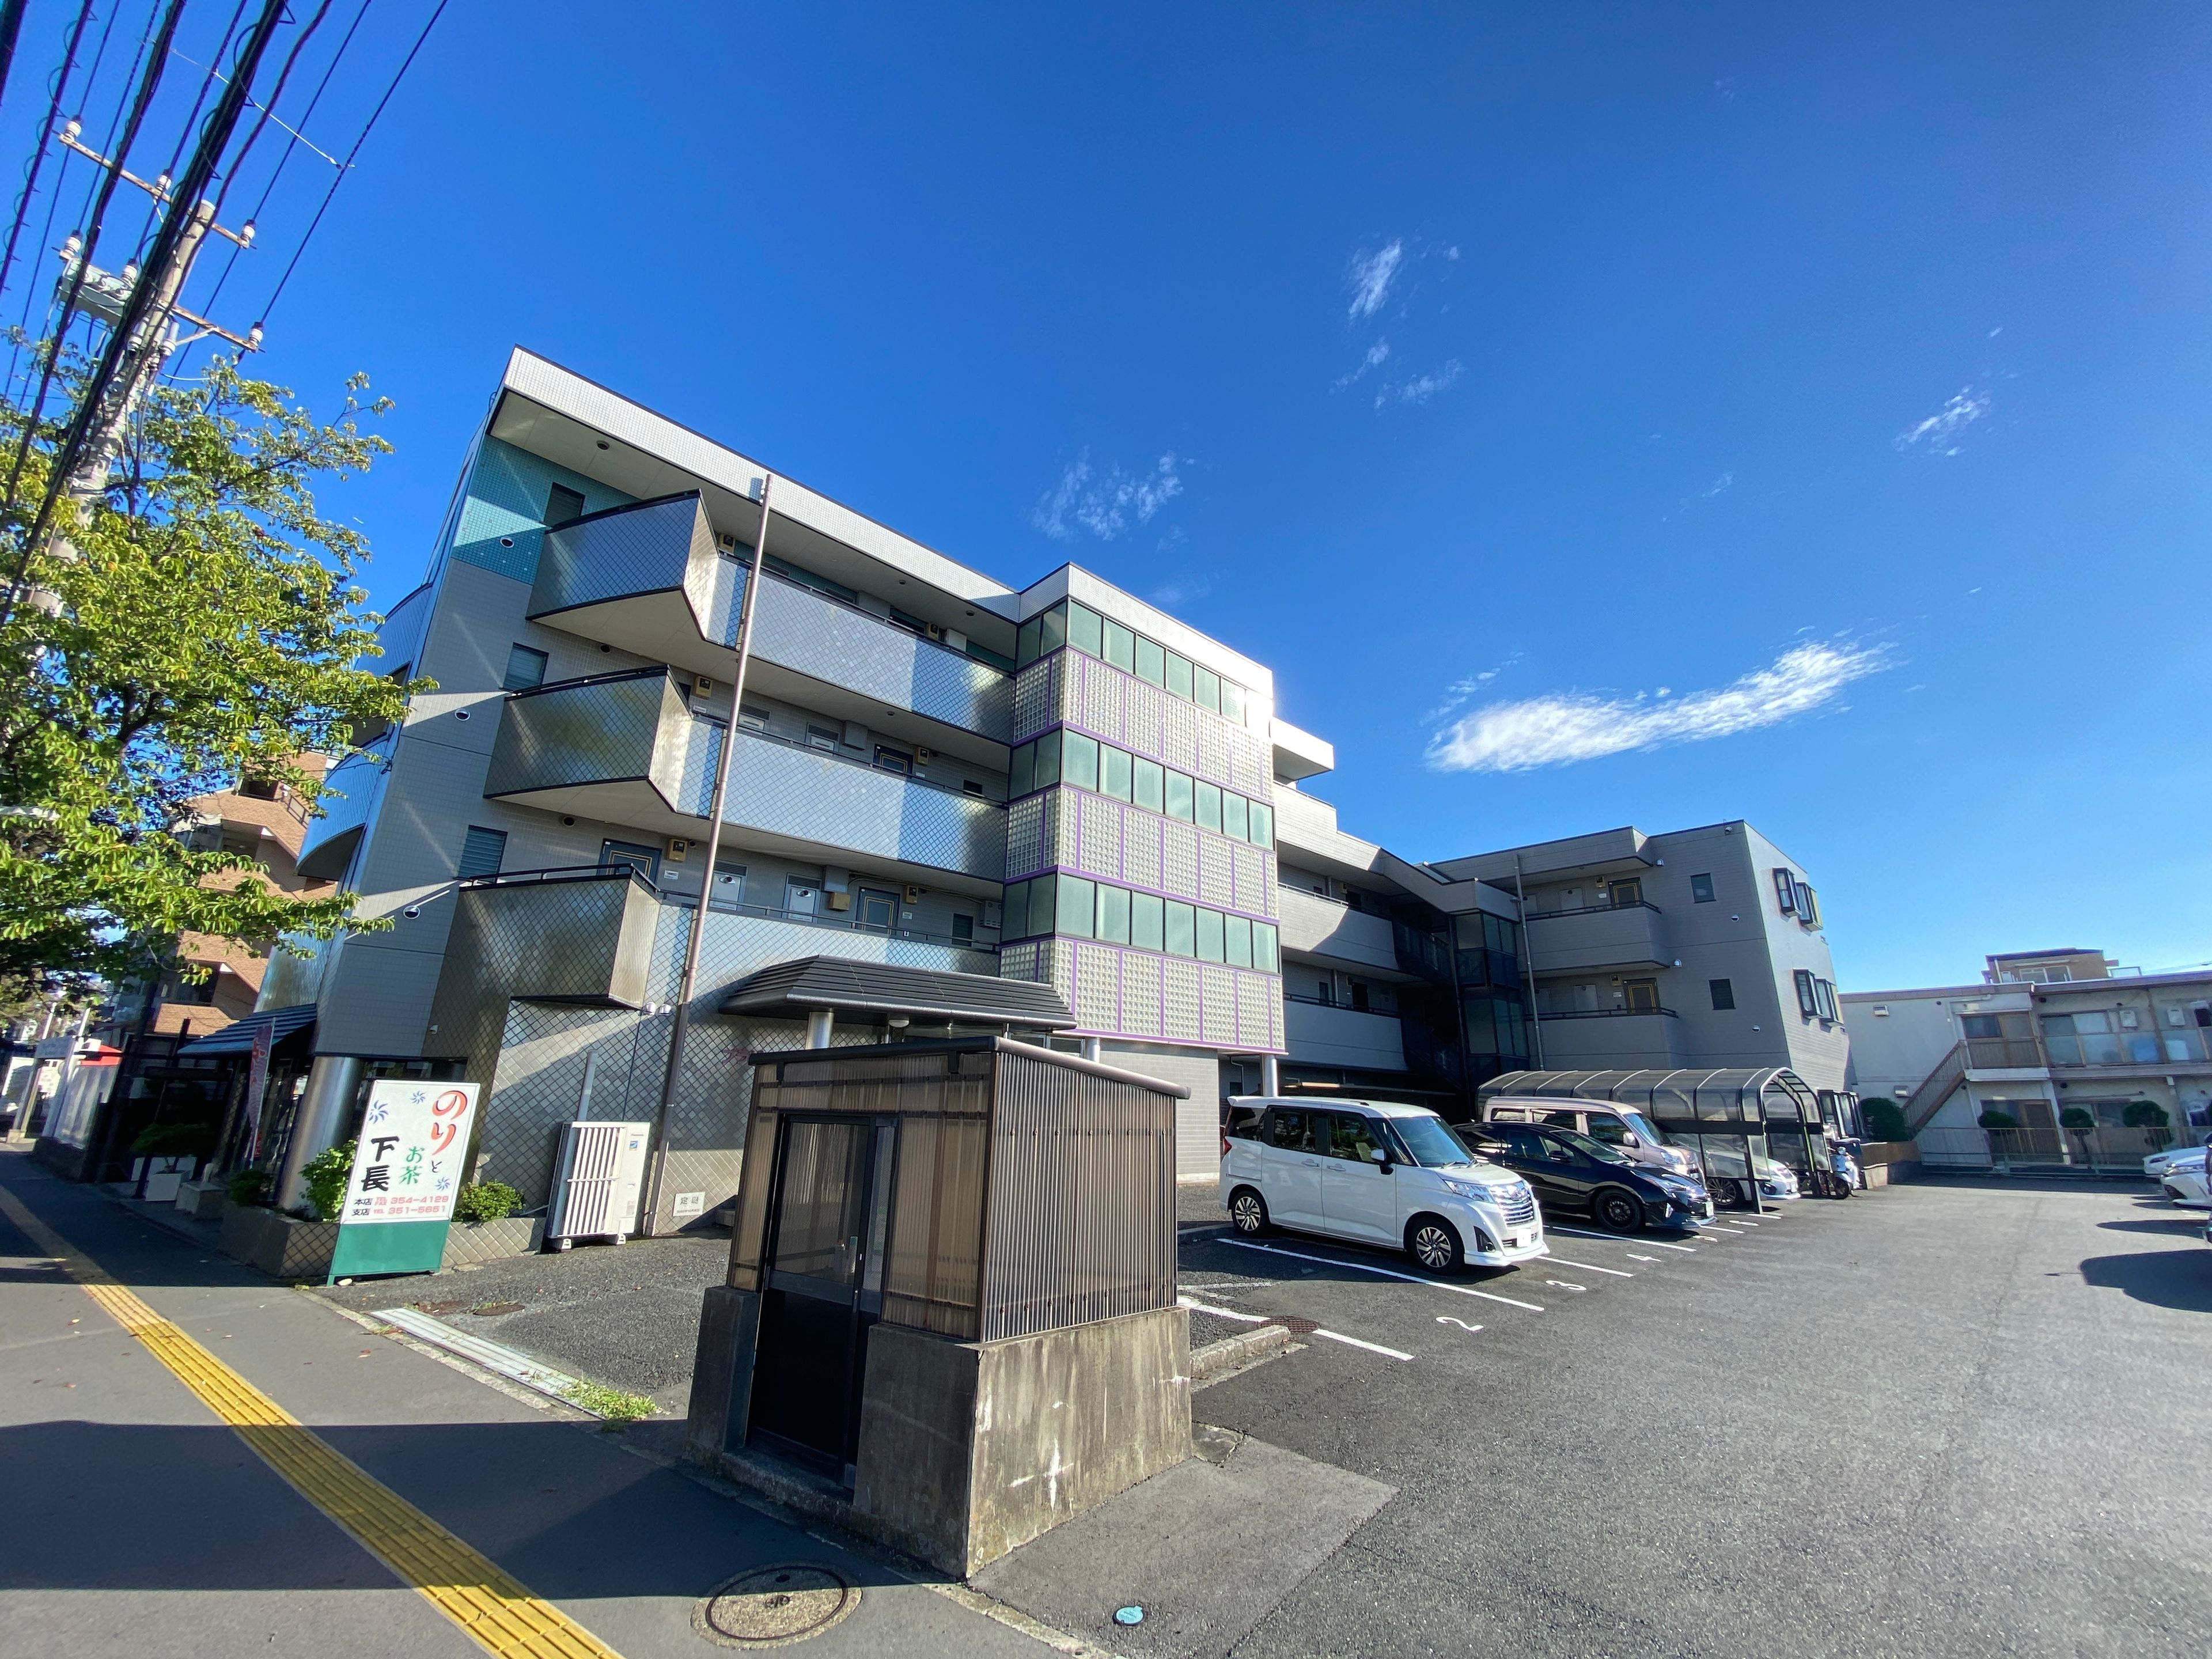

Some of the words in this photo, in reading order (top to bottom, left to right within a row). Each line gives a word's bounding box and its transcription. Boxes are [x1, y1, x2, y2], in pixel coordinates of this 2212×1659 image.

[361, 1136, 400, 1192] 下長
[399, 1146, 425, 1185] お茶
[354, 1198, 373, 1206] 本店
[351, 1208, 370, 1217] 支店
[1546, 1280, 1587, 1291] 3
[1435, 1316, 1484, 1331] 2
